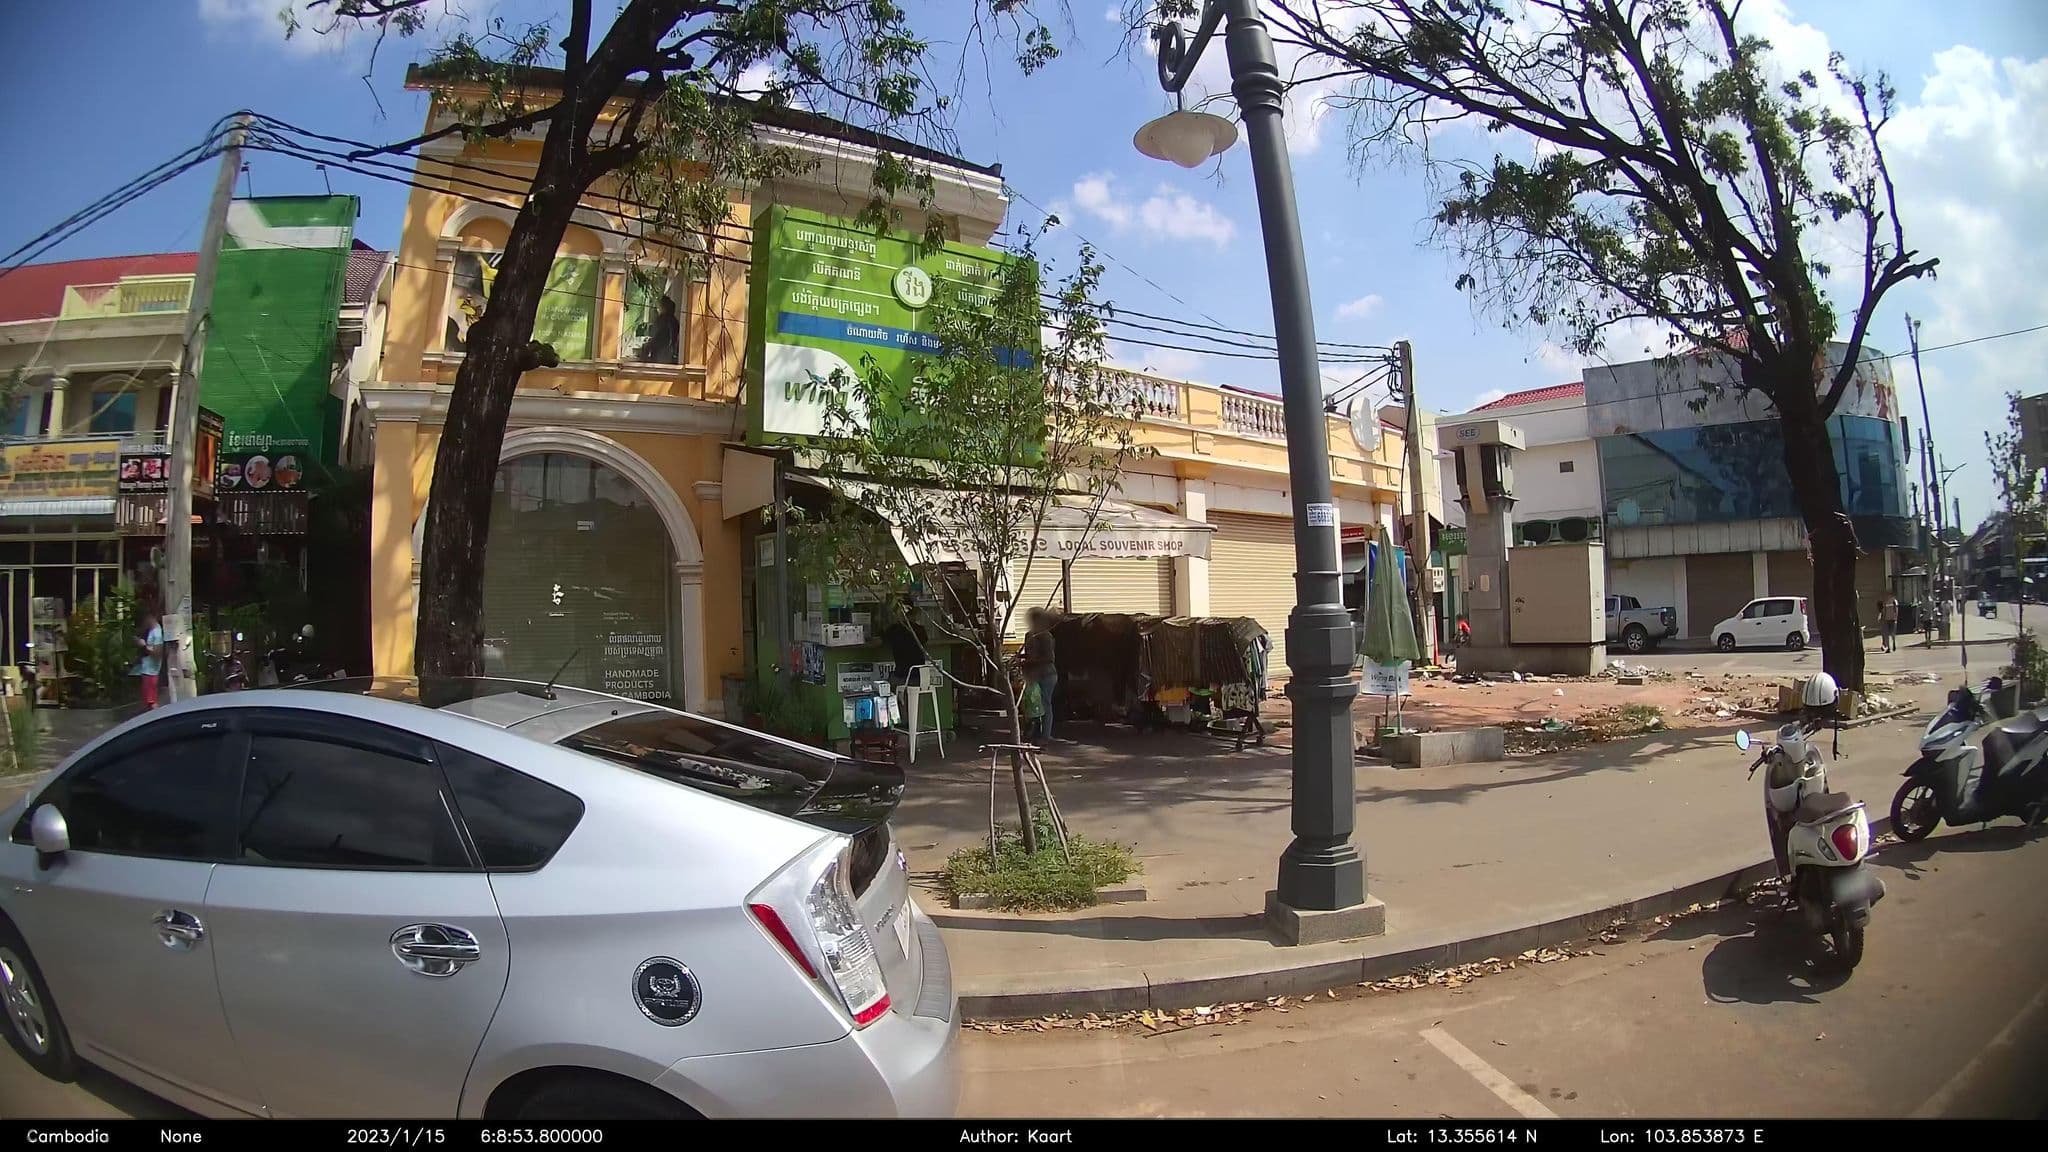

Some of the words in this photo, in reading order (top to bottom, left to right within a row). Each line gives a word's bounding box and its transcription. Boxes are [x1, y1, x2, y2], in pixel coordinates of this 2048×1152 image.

[1058, 540, 1096, 551] LOCAL
[1100, 540, 1155, 551] SOUVENIR
[1157, 540, 1184, 551] SHOP
[605, 669, 660, 678] HANDMADE
[605, 681, 654, 689] PRODUCTS
